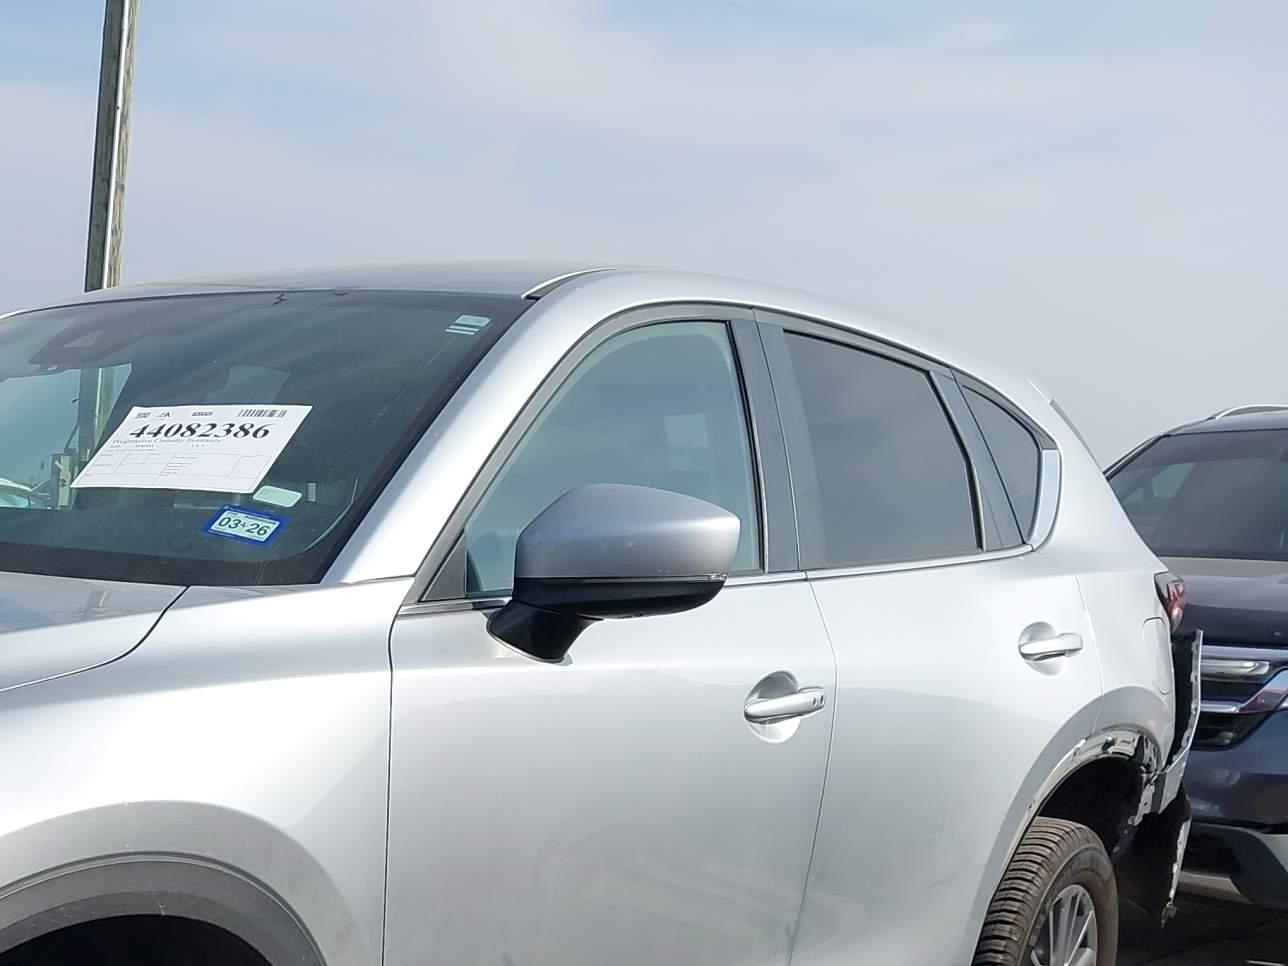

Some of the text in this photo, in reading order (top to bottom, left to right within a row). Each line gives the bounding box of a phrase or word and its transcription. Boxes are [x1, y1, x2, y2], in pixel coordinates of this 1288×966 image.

[130, 423, 274, 439] 44082386
[218, 516, 242, 530] 03
[246, 522, 271, 537] 26
